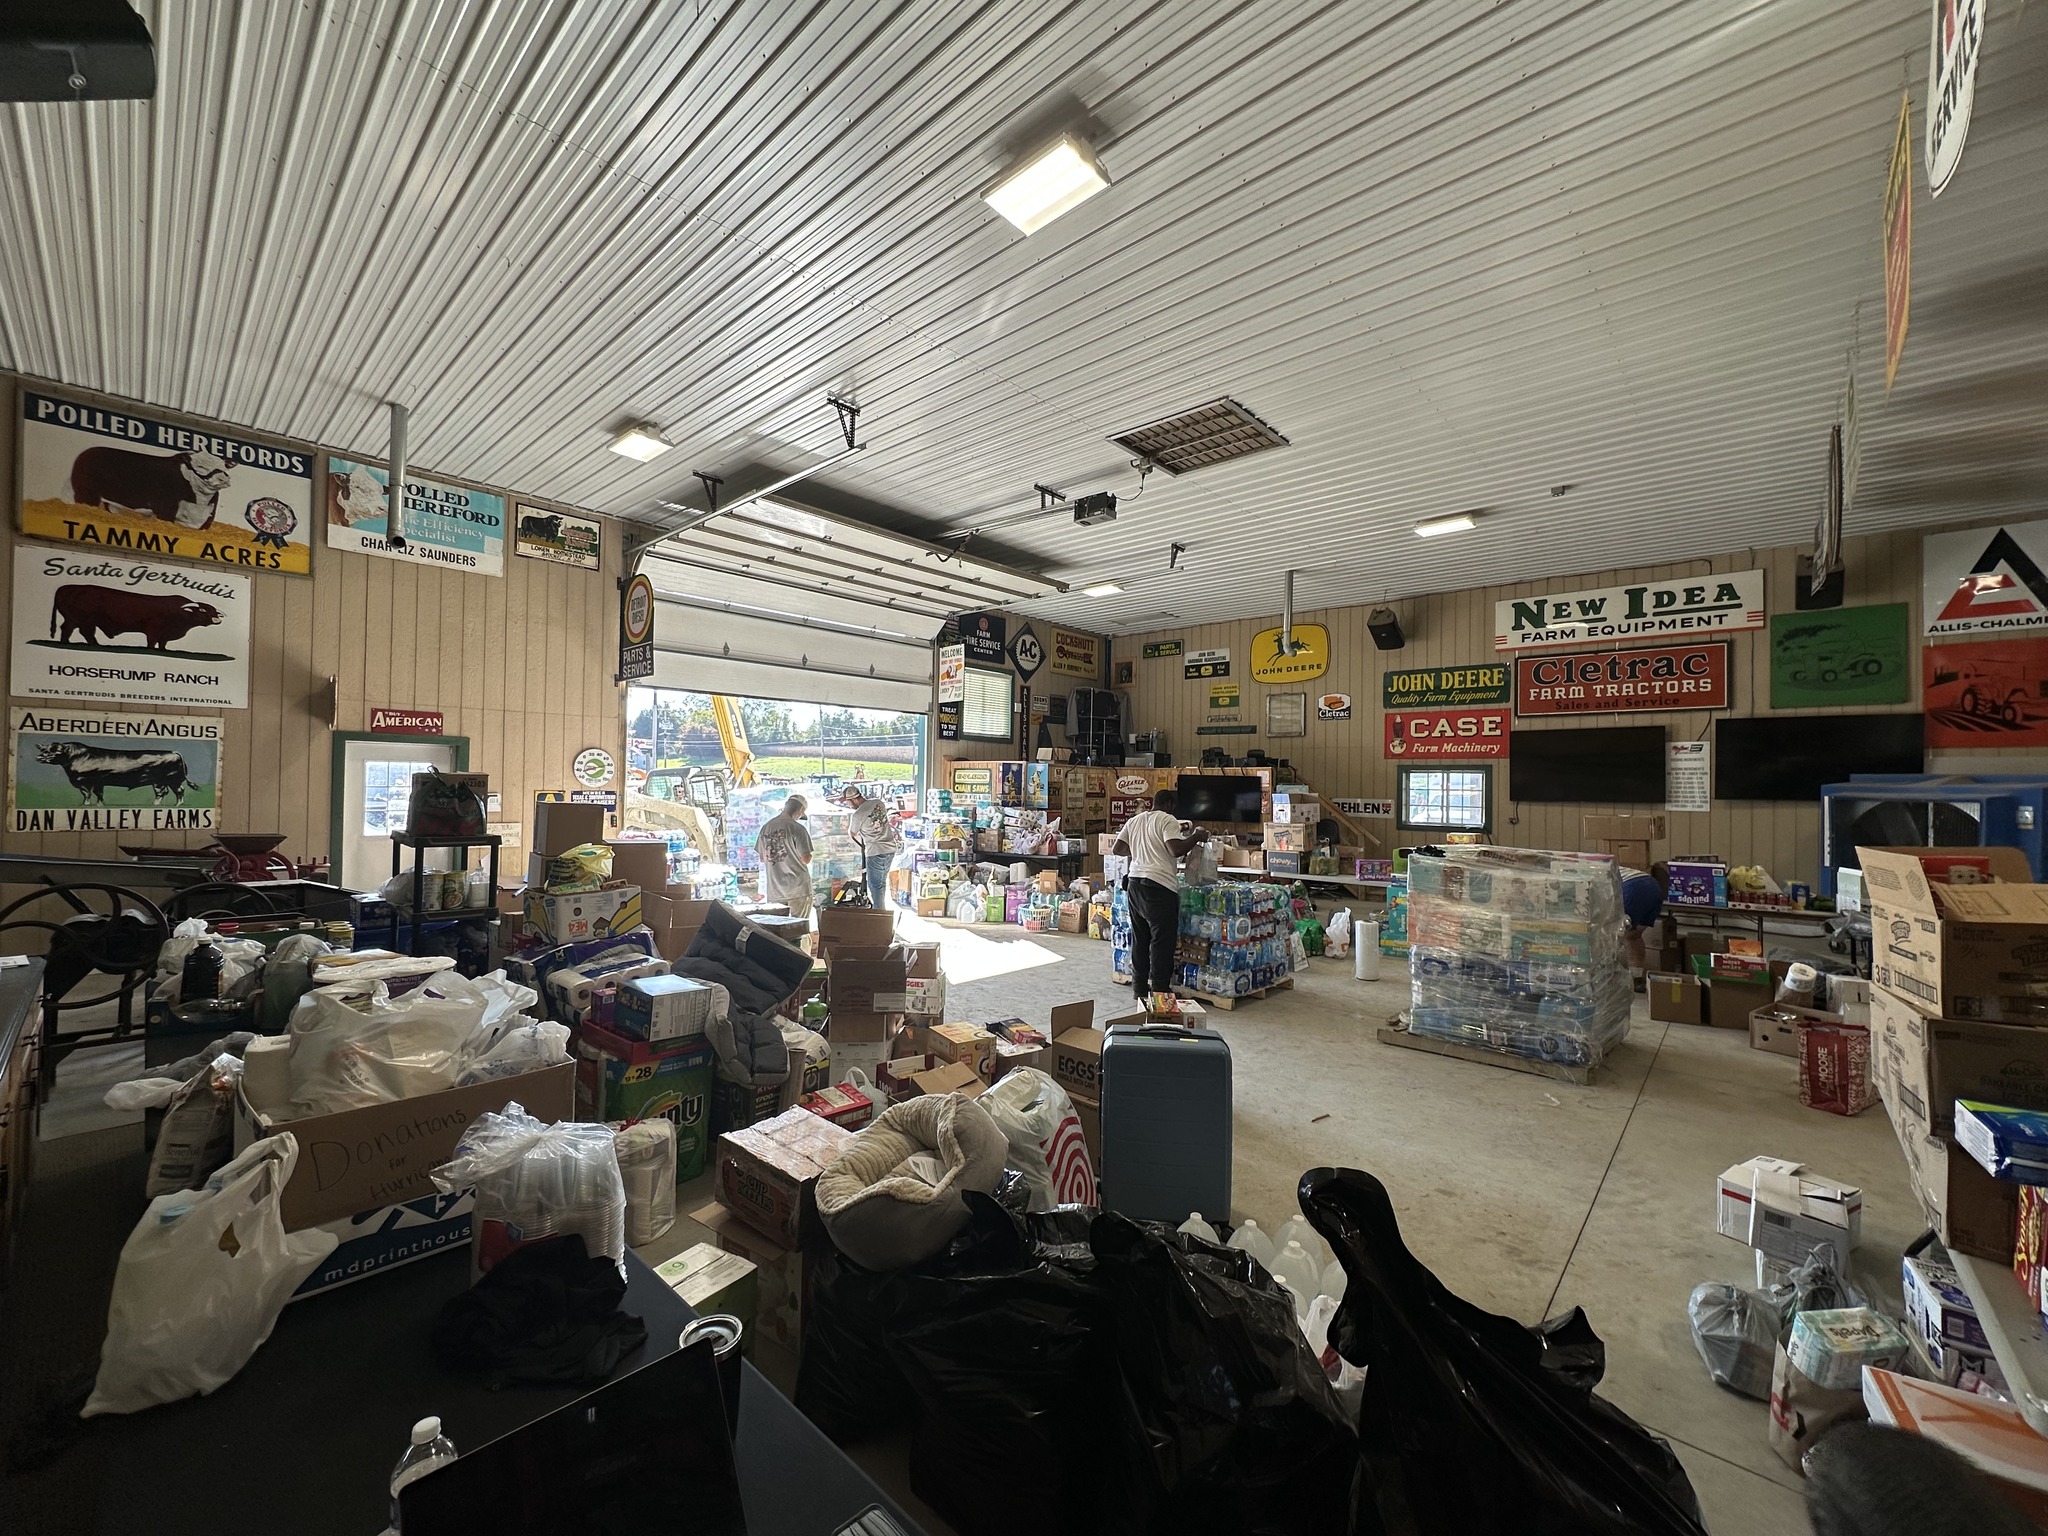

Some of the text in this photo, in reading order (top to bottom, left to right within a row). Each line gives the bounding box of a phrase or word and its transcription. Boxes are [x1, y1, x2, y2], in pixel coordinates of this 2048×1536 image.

[37, 399, 305, 474] POLLED HEREFORDS
[404, 483, 470, 507] OLLED
[63, 519, 281, 570] TAMMY ACRES
[403, 527, 457, 545] pecialist
[420, 547, 476, 568] SAUNDERS
[43, 557, 236, 600] Santa Gertrudis
[1511, 582, 1742, 632] NEW IDEA
[976, 629, 991, 638] FARM
[1521, 613, 1729, 644] FARM EQUIPMENT
[973, 647, 994, 655] CENTER
[980, 638, 1001, 651] SERVICE
[1055, 632, 1095, 652] COCKSHUTT
[623, 645, 652, 664] PARTS &
[941, 647, 963, 658] WELCOME
[1159, 648, 1180, 656] SERVICE
[49, 665, 219, 686] HORSERUMP RANCH
[622, 660, 652, 679] SERVICE
[1256, 663, 1323, 676] JOHN DEERE
[1531, 651, 1711, 686] Cletrac
[1387, 667, 1505, 693] JOHN DEERE
[1529, 677, 1713, 701] FARM TRACTORS
[28, 687, 233, 705] SANTA GERTRUDIS BREEDERS INTERNATIONAL
[1391, 690, 1501, 706] Quality Farm Equipment
[1555, 695, 1680, 711] Sales and Service
[372, 711, 442, 728] AMERICAN
[941, 706, 957, 714] TREAT
[1318, 709, 1350, 718] Cletrac
[19, 713, 218, 738] ABERDEEN ANGUS
[1410, 716, 1502, 738] CASE
[1412, 742, 1501, 754] Farm Machinery
[954, 784, 989, 793] CHAIN SAWS
[16, 808, 213, 831] DAN VALLEY FARMS
[635, 1066, 652, 1080] 28
[1057, 1054, 1095, 1082] EGGS
[310, 1108, 467, 1193] Donations
